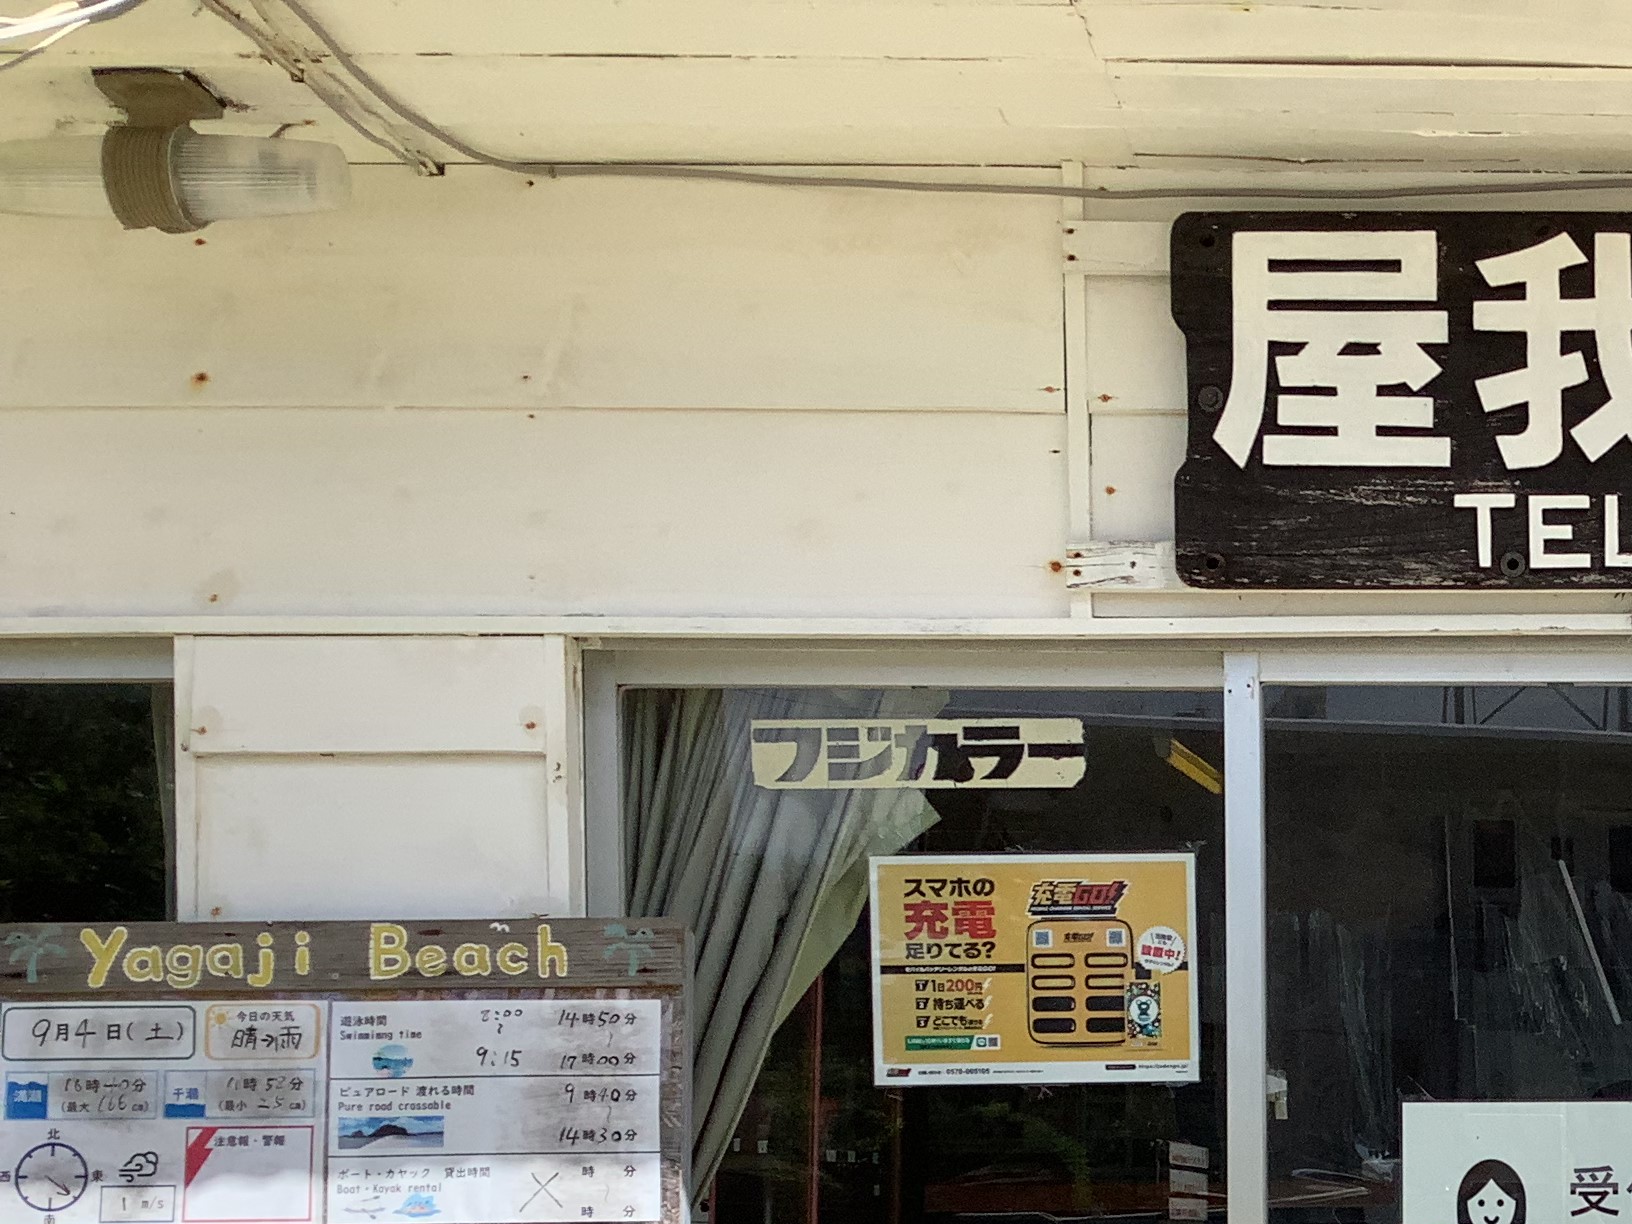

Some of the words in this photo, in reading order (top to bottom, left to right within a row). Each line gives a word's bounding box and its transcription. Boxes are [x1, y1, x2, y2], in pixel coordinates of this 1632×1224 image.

[752, 725, 1086, 783] フジカラー
[904, 878, 995, 898] スマホの
[904, 900, 996, 940] 充電
[80, 926, 312, 989] Yagaji
[368, 924, 569, 981] Beach
[236, 1010, 295, 1022] 今日の天気
[398, 1030, 423, 1040] time
[338, 1102, 363, 1111] Pure
[369, 1101, 393, 1111] road
[47, 1129, 60, 1140] 北
[407, 1182, 442, 1193] rental
